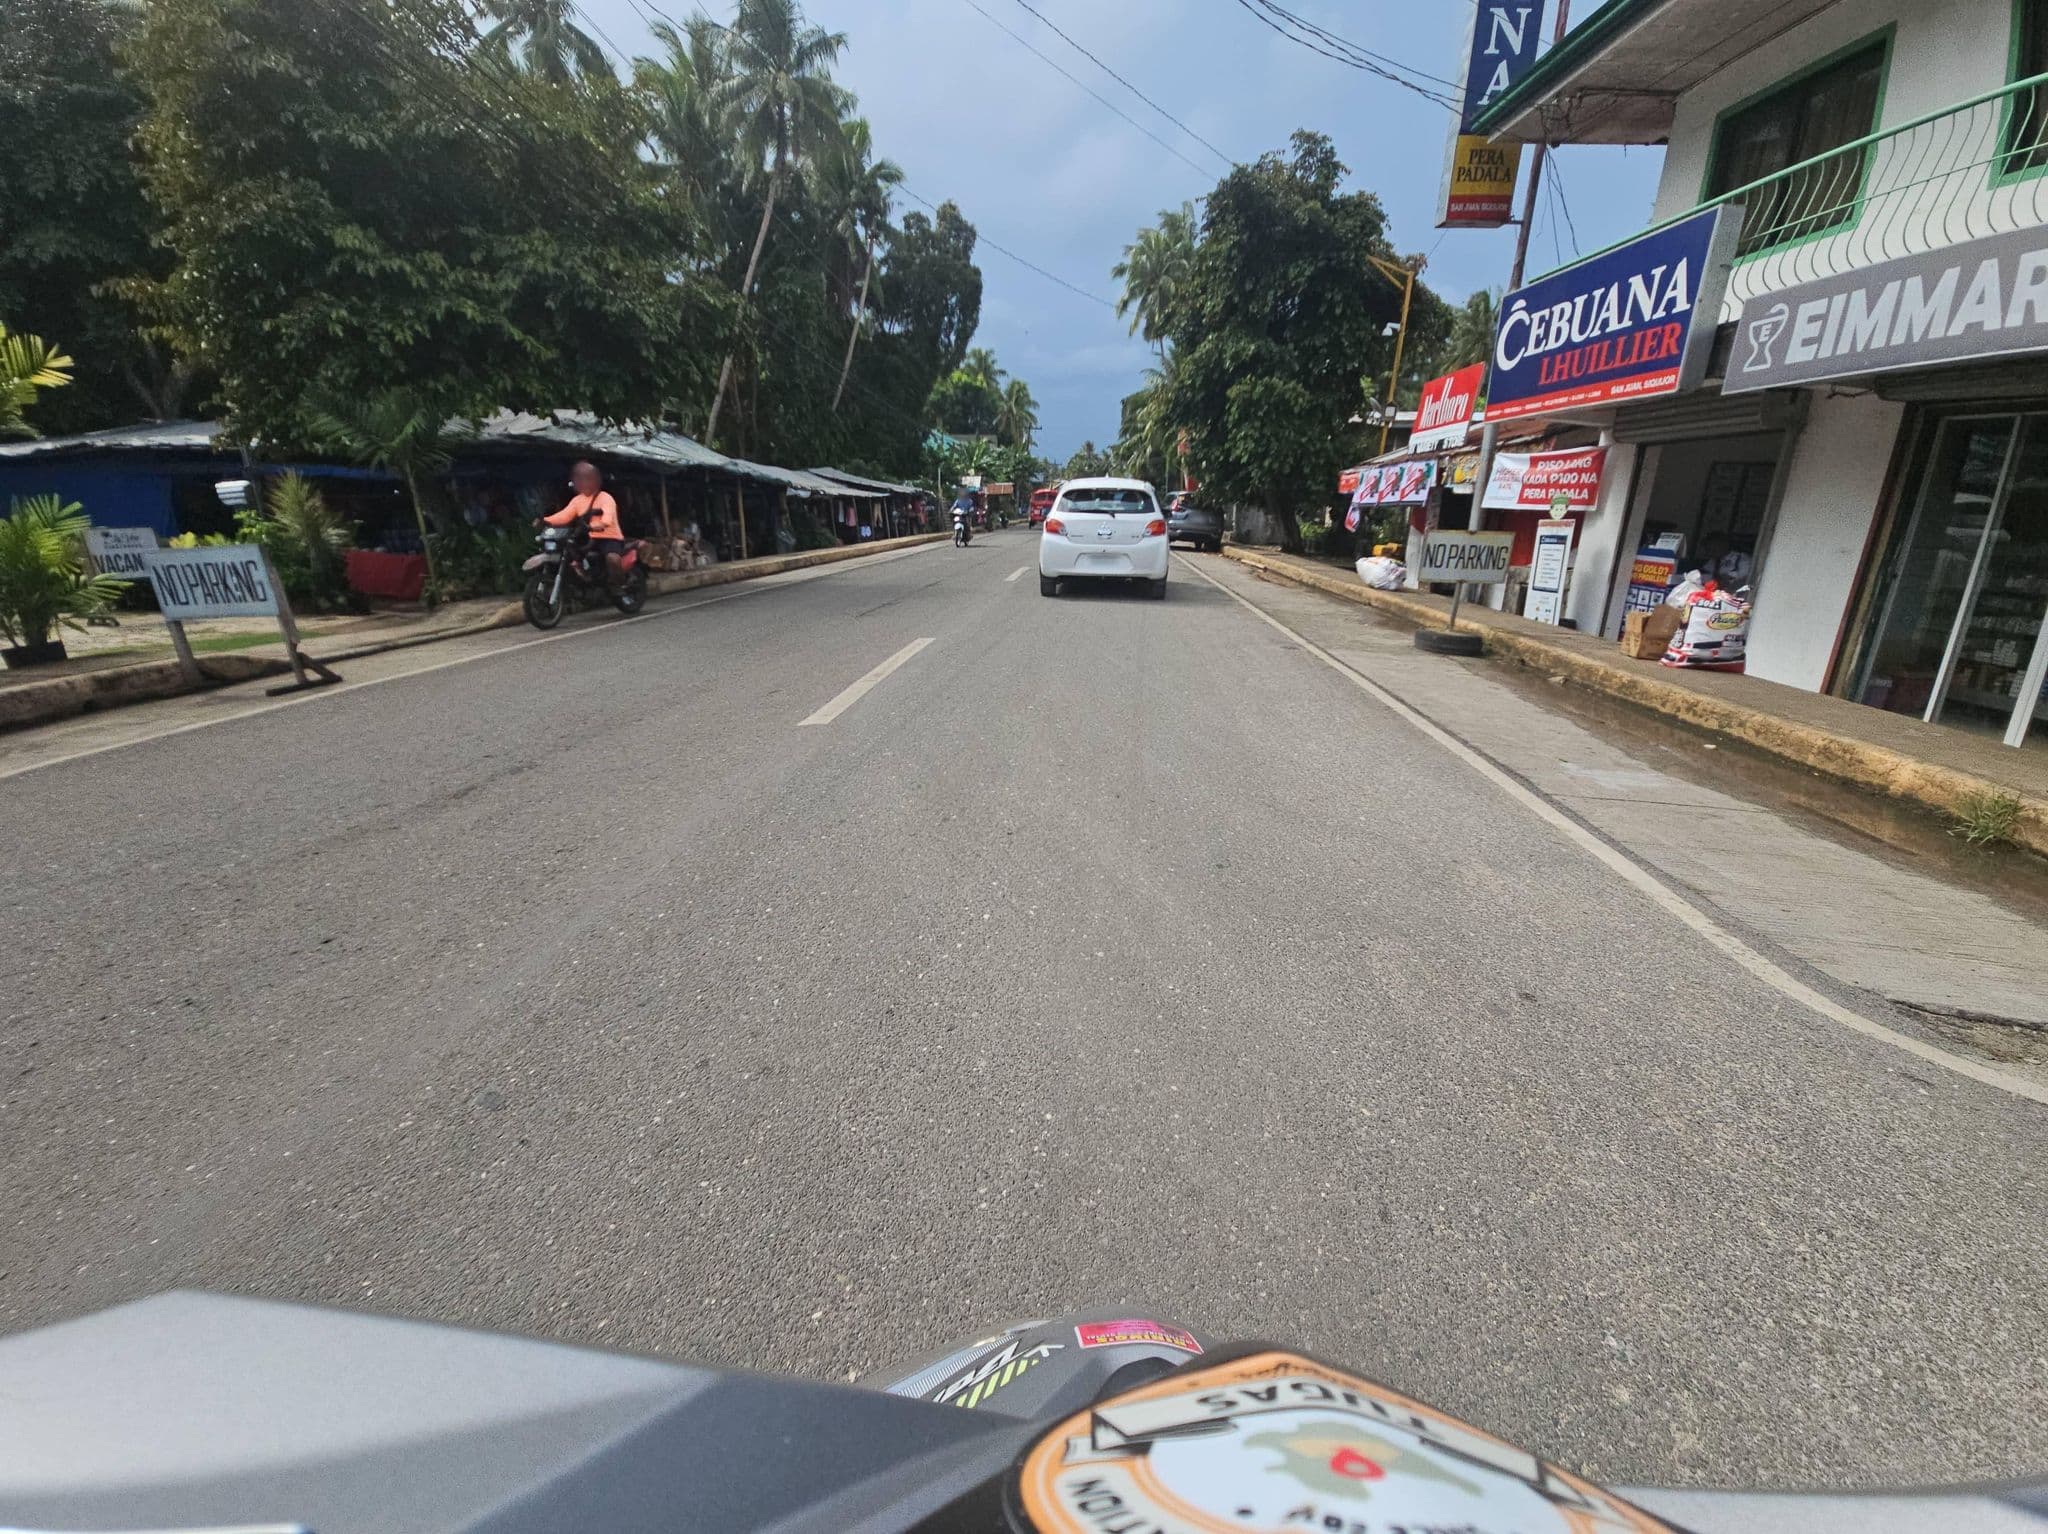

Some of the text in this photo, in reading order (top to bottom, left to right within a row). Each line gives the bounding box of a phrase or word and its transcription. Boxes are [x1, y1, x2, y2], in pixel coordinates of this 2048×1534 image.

[1468, 149, 1505, 166] PERA
[1455, 166, 1512, 183] PADALA
[1496, 257, 1691, 371] CEBUANA
[1538, 323, 1682, 386] LHUILLIER
[1418, 376, 1469, 430] Marlboro
[1523, 473, 1548, 485] KADA
[1580, 472, 1598, 484] NA
[1522, 488, 1589, 500] PERA PADALA
[94, 553, 144, 575] VACAN
[1423, 543, 1509, 570] NO PARKING
[151, 560, 268, 607] NO PARKING
